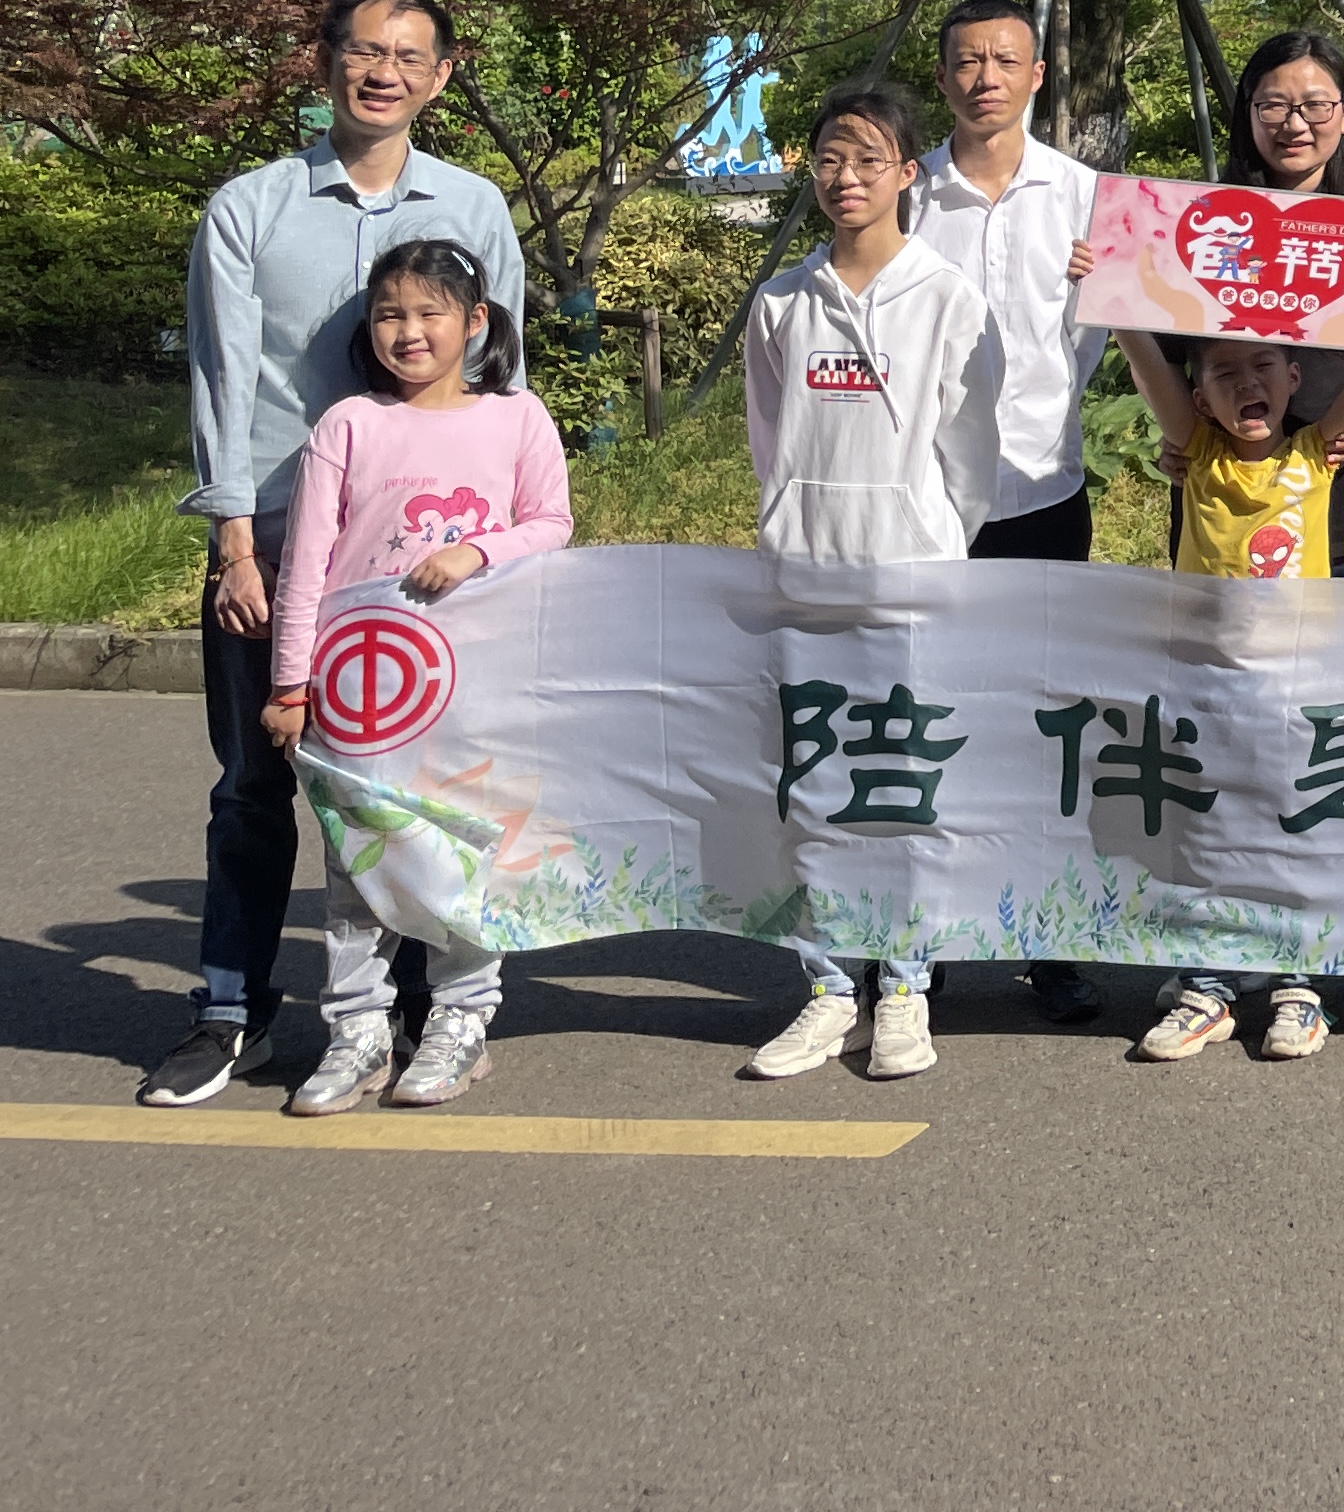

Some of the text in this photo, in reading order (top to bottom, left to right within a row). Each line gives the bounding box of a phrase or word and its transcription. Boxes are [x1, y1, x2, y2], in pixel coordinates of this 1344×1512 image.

[1280, 221, 1337, 235] FATHER'S
[1220, 288, 1319, 311] 爸爸我爱你
[384, 475, 439, 492] pinkie pie
